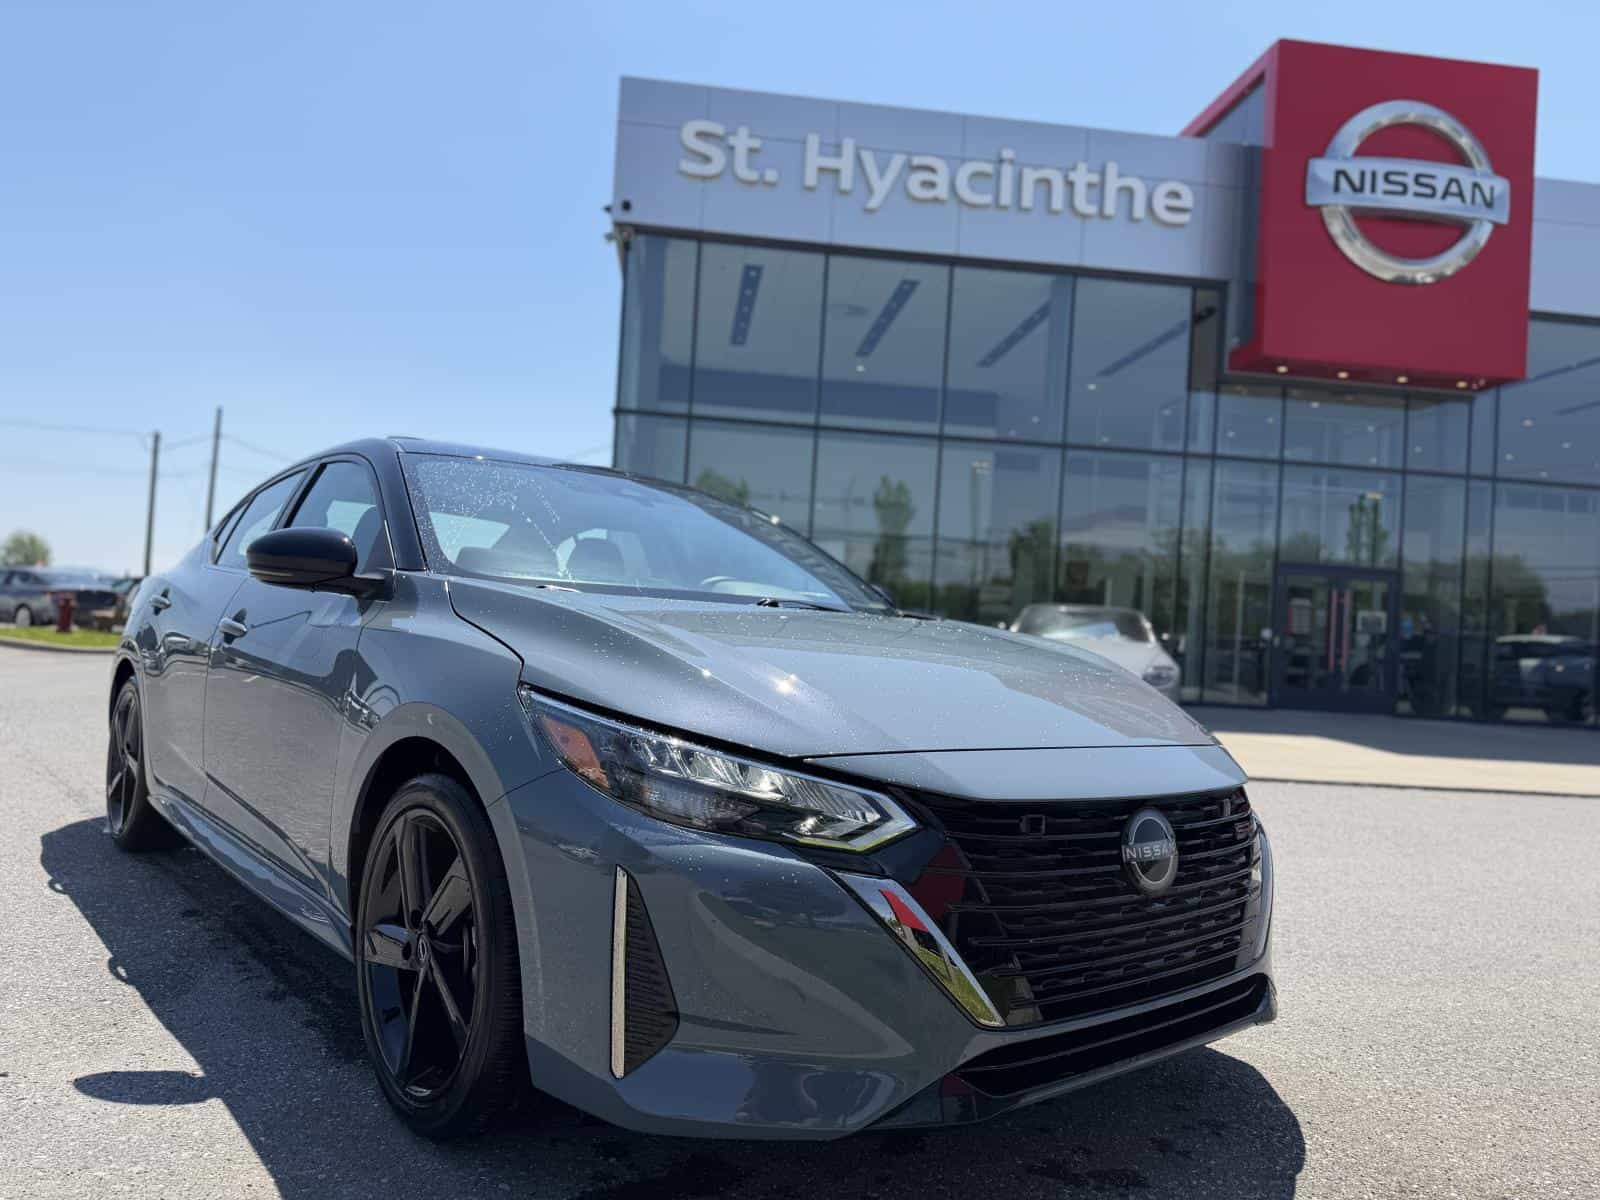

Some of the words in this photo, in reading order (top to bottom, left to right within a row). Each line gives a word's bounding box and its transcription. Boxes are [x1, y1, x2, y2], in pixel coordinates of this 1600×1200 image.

[679, 119, 778, 184] St.
[803, 132, 1195, 225] Hyacinthe
[1333, 169, 1495, 209] NISSAN
